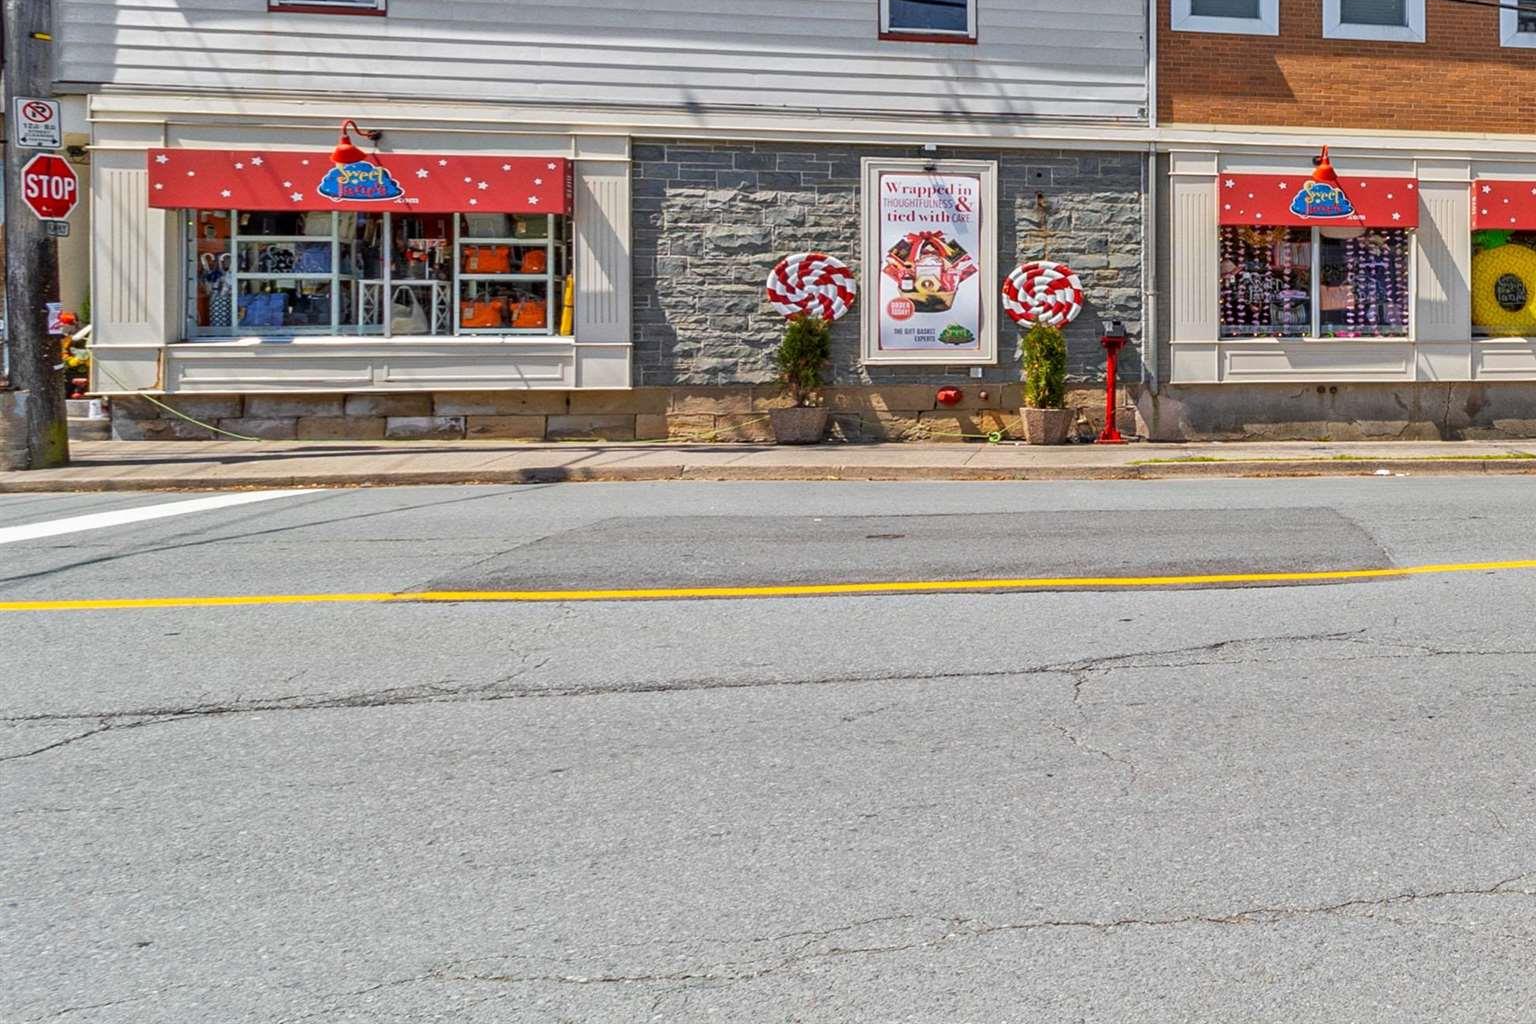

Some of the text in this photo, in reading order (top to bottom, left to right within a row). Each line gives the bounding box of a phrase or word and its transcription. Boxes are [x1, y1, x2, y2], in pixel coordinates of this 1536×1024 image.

[337, 163, 385, 185] Sweet
[26, 173, 75, 200] STOP
[886, 182, 972, 198] Wrapped in
[1304, 180, 1340, 204] Sweet
[883, 196, 972, 212] THOUGHTFULNESS &
[887, 210, 915, 222] tied
[919, 211, 950, 222] with
